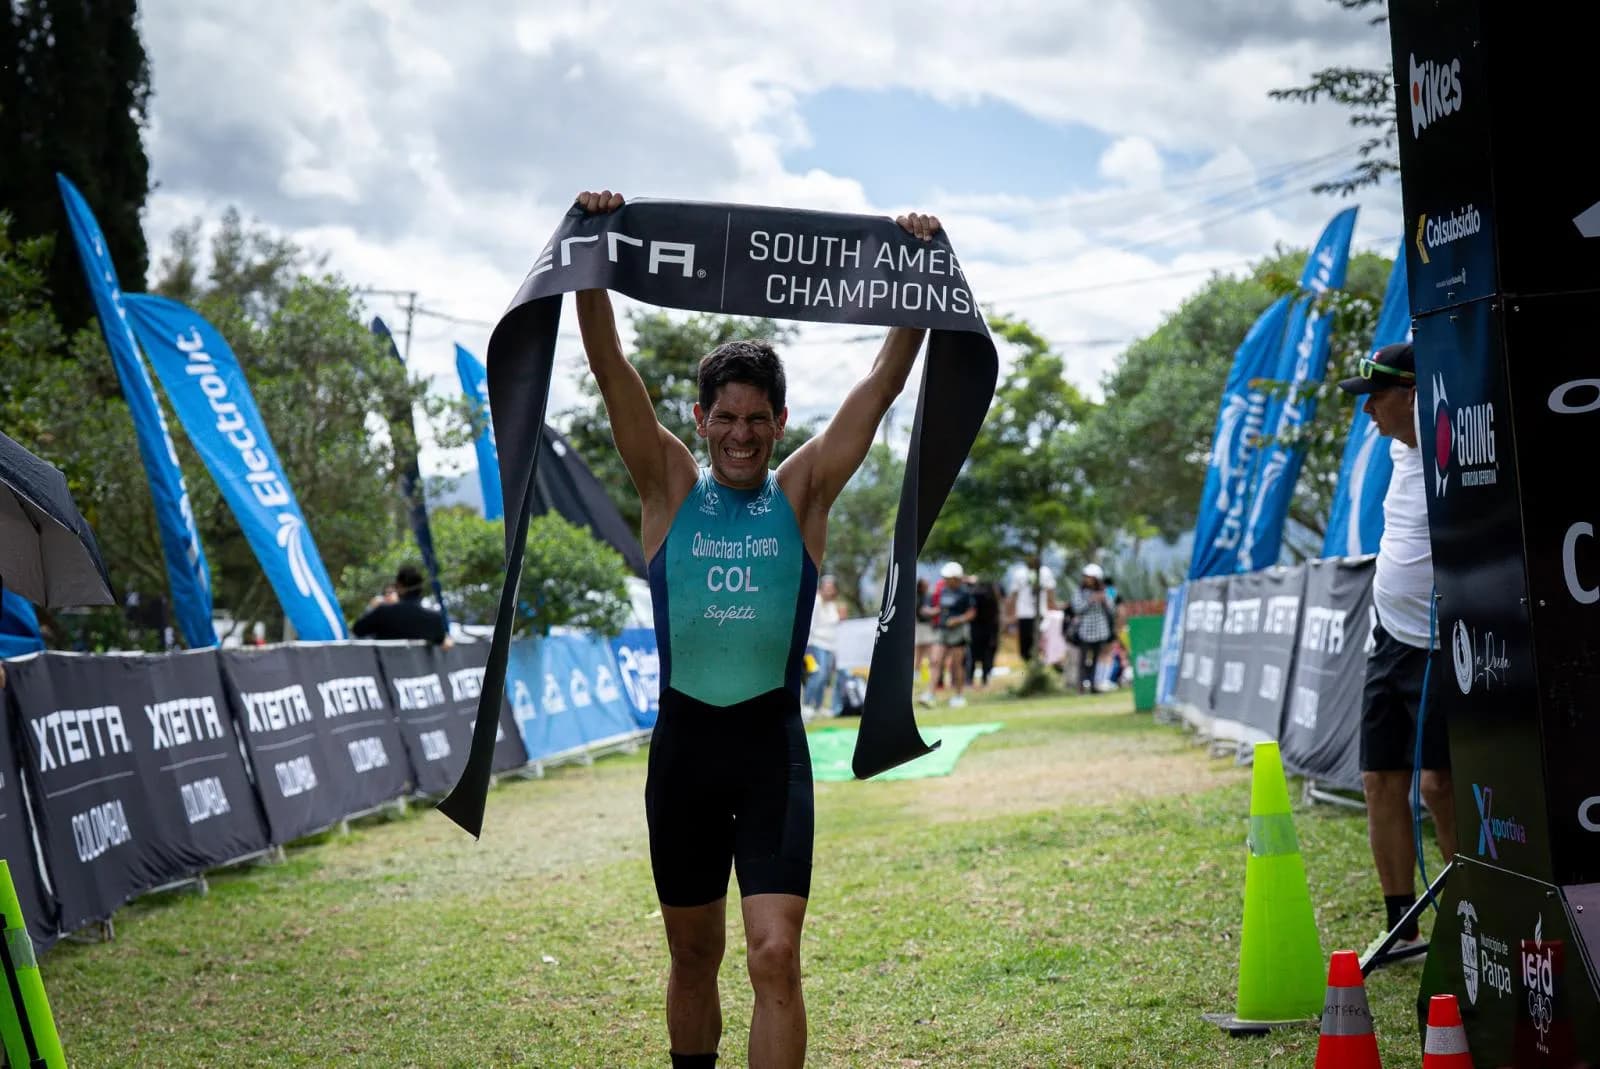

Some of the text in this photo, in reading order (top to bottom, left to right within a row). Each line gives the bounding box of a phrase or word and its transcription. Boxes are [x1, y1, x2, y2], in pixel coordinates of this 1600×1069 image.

[1426, 203, 1481, 248] Colsubsidio
[749, 230, 861, 269] SOUTH
[1457, 402, 1496, 467] GOING
[692, 531, 779, 559] Quinchara Forero
[707, 565, 759, 592] COL
[703, 604, 758, 626] Safetti
[240, 684, 313, 732] XTERRA
[316, 676, 384, 718] XTERRA
[31, 705, 132, 772] XTERRA
[144, 696, 224, 750] XTERRA
[1481, 949, 1512, 999] Paipa
